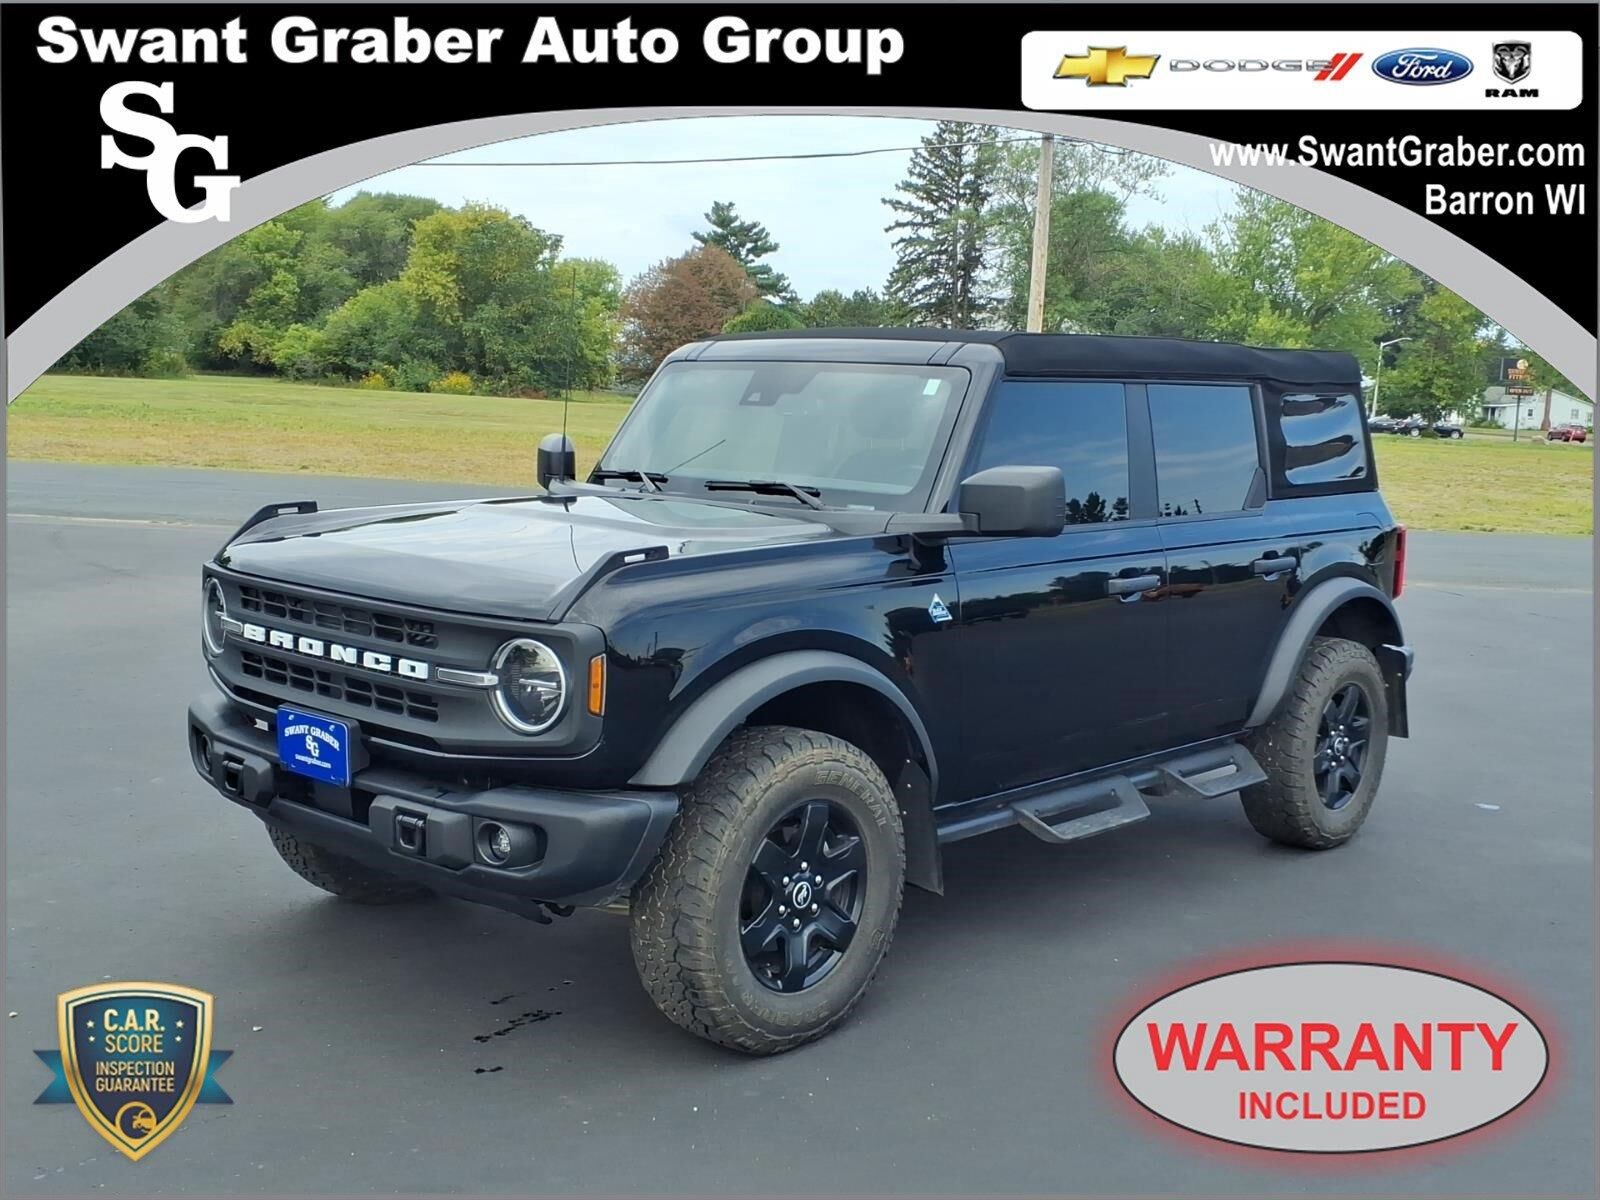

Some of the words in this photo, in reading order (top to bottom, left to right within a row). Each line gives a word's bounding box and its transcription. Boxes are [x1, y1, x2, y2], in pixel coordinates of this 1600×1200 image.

[243, 623, 429, 680] BRONCO
[284, 724, 310, 737] SWANT
[310, 726, 340, 751] GRABER
[815, 770, 888, 827] GENERAL
